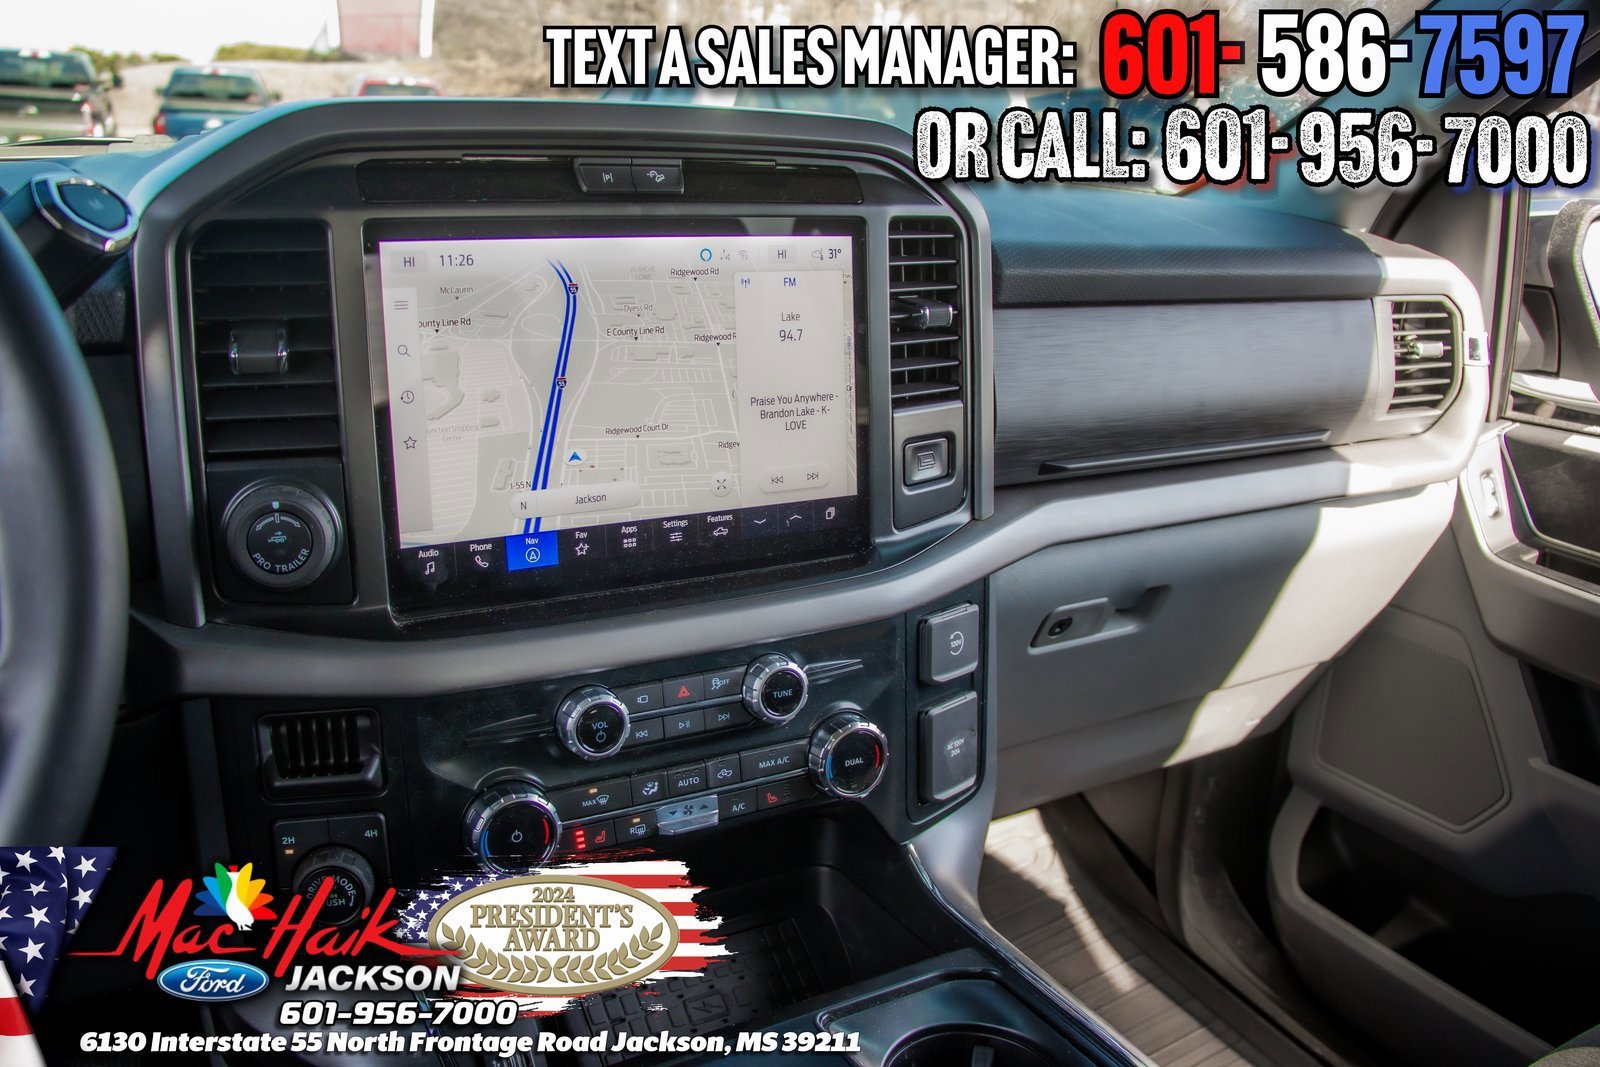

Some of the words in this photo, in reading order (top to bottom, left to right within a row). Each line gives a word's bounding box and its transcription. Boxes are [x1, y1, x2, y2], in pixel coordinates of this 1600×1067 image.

[777, 250, 787, 259] HI
[403, 257, 416, 267] HI
[439, 254, 474, 267] 11:26
[670, 267, 710, 278] Ridgewood
[710, 267, 720, 276] Rd
[783, 277, 797, 287] FM
[440, 286, 474, 295] McLaurin
[624, 304, 643, 313] Dyess
[643, 303, 653, 312] Rd
[442, 317, 459, 327] Line
[460, 317, 472, 326] Rd
[781, 312, 801, 322] Lake
[607, 328, 612, 336] E
[612, 327, 638, 337] County
[639, 326, 654, 335] Line
[655, 326, 665, 335] Rd
[779, 329, 803, 342] 94.7
[694, 331, 732, 343] Ridgewood
[750, 396, 776, 407] Praise
[776, 395, 793, 405] You
[794, 393, 834, 406] Anywhere
[760, 408, 794, 420] Brandon
[796, 407, 815, 418] Lake
[821, 406, 831, 416] K-
[605, 425, 642, 436] Ridgewood
[643, 424, 660, 433] Court
[661, 422, 669, 431] Dr
[785, 420, 807, 431] LOVE
[575, 493, 607, 505] Jackson
[520, 501, 527, 511] N
[662, 518, 689, 529] Settings
[707, 514, 733, 523] Features
[621, 525, 638, 534] Apps
[575, 531, 588, 539] Fav
[525, 536, 539, 545] Nav
[470, 542, 492, 551] Phone
[418, 549, 439, 558] Audio
[252, 552, 272, 570] PRO
[275, 547, 310, 573] TRAILER
[772, 688, 793, 698] TUNE
[591, 720, 609, 730] VOL
[758, 760, 775, 769] MAX
[776, 755, 790, 765] A/C
[845, 757, 864, 767] DUAL
[677, 776, 700, 788] AUTO
[582, 799, 597, 807] MAX
[732, 802, 746, 812] A/C
[364, 829, 378, 838] 4H
[281, 836, 295, 845] 2H
